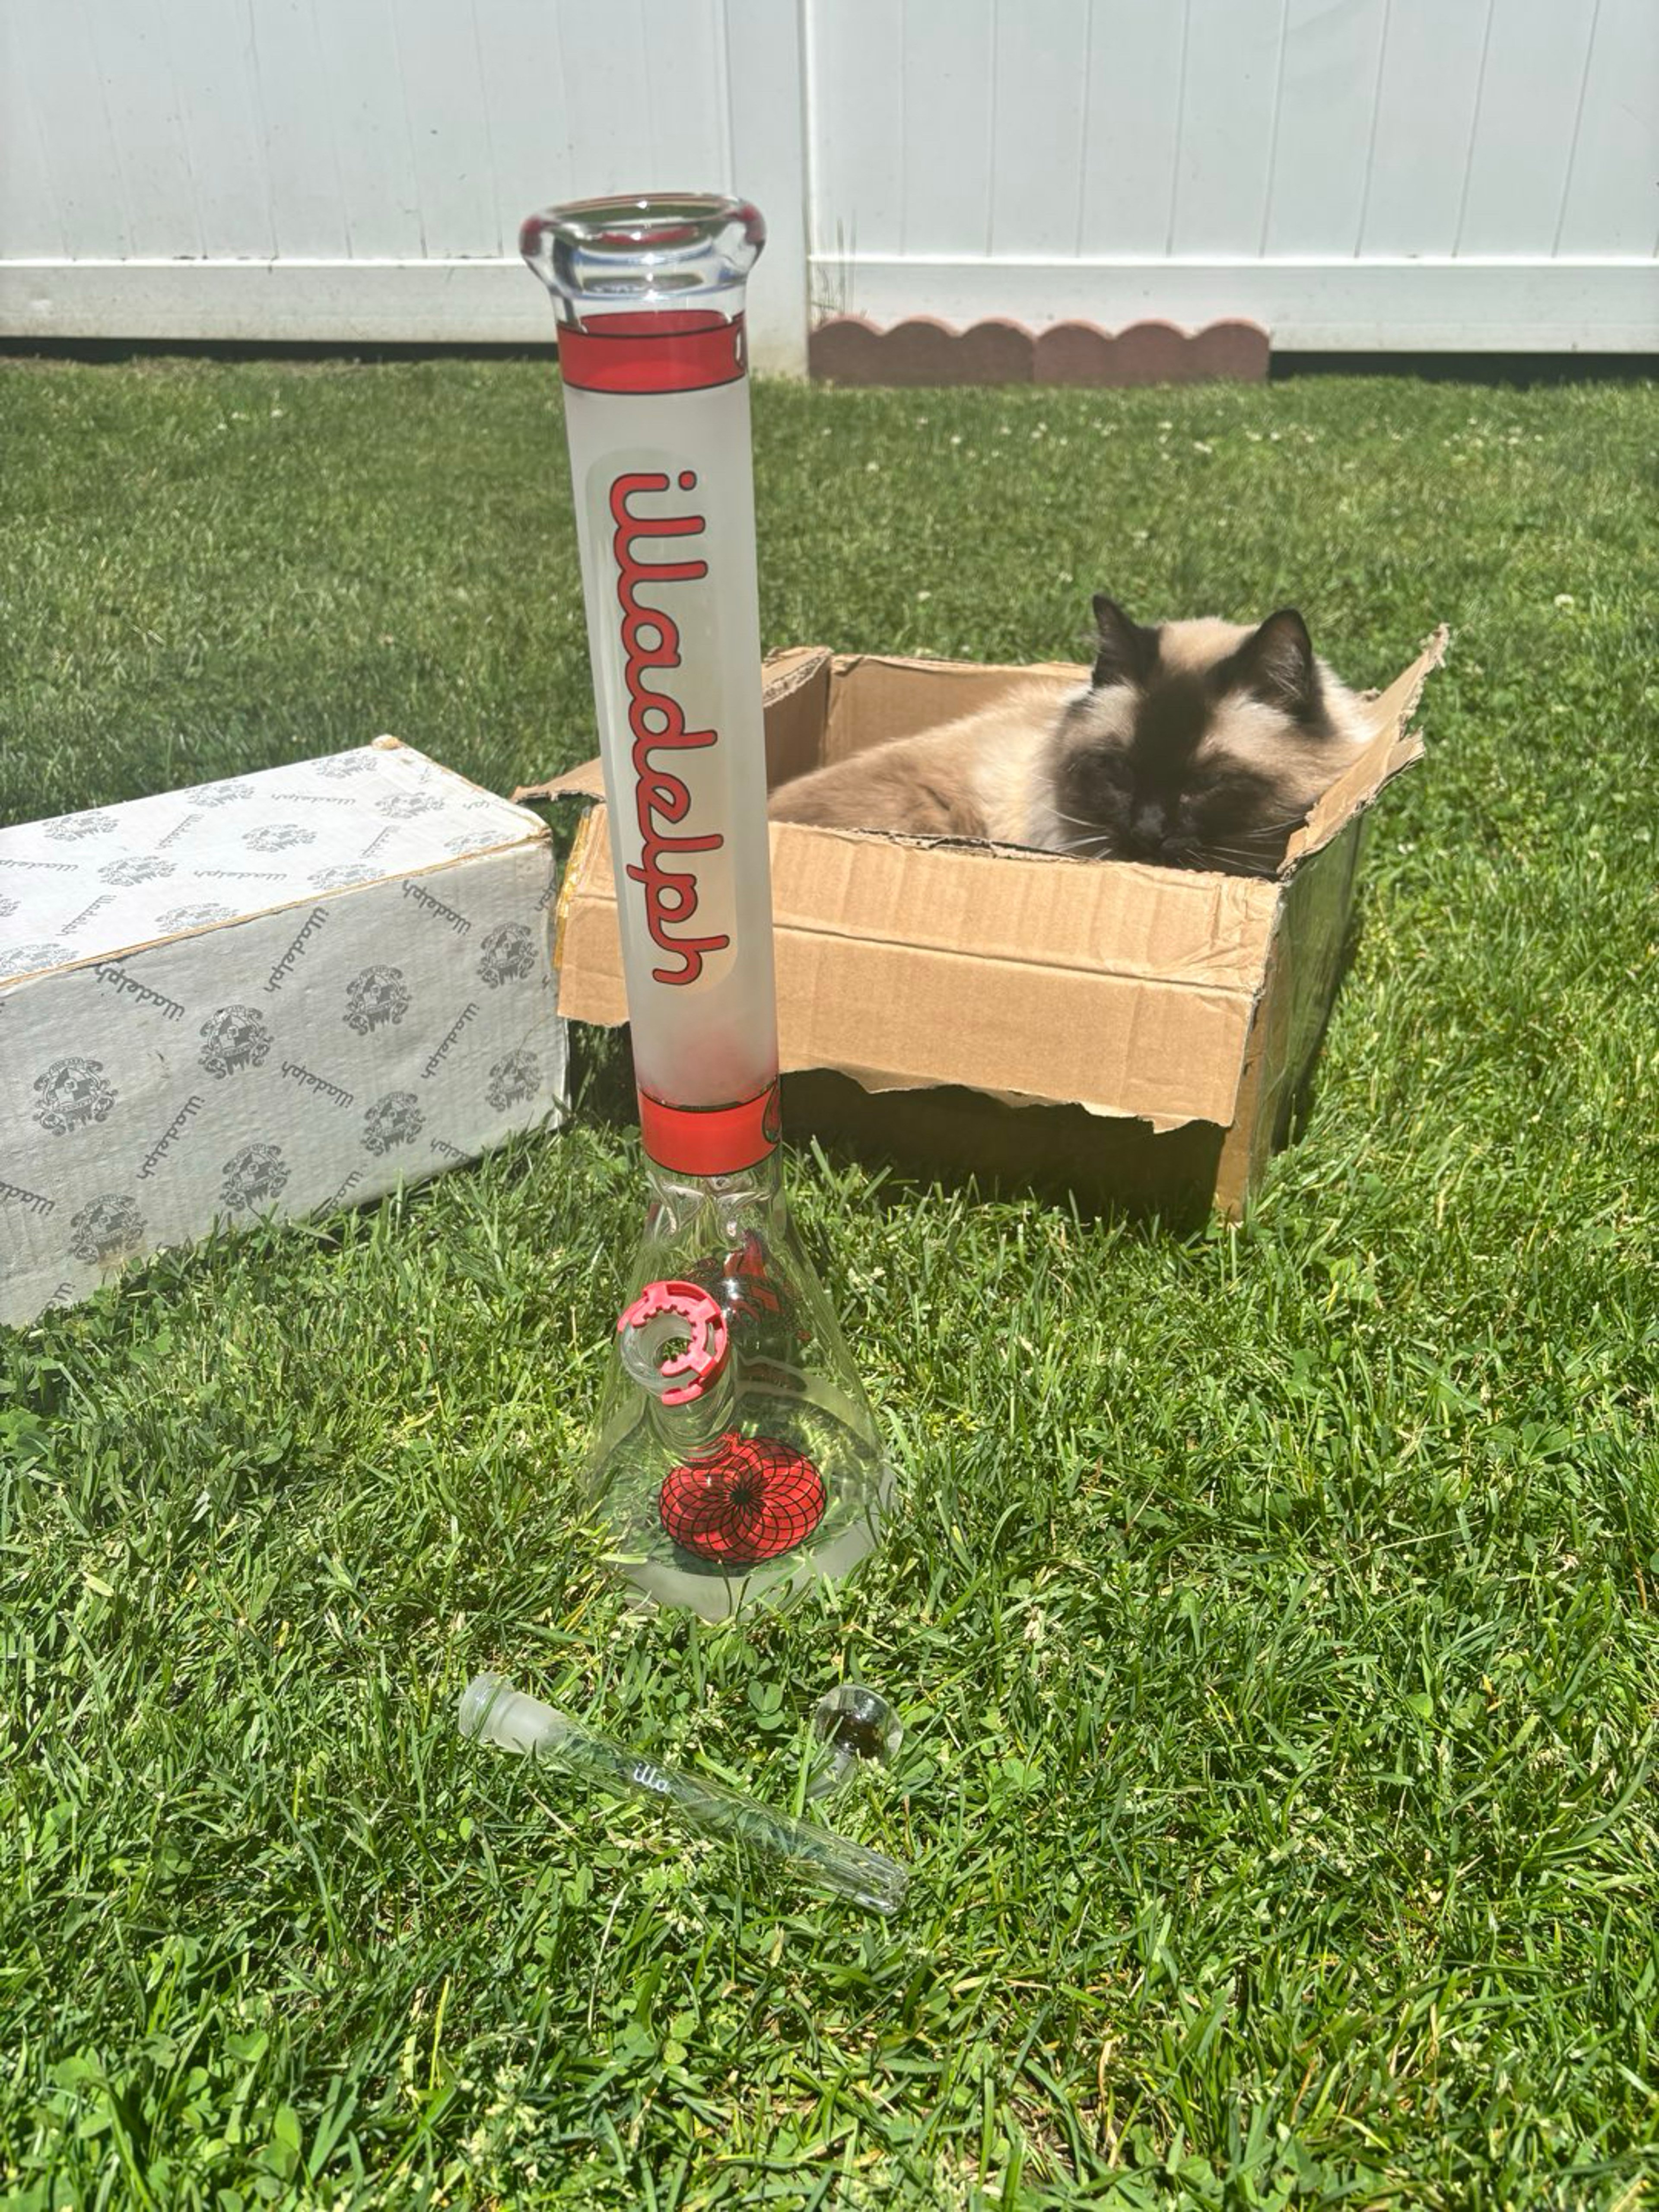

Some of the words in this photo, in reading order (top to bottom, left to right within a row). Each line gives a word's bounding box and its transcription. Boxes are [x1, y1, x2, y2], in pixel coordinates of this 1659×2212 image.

[610, 471, 730, 985] illadelph
[0, 859, 78, 871] illadelp
[194, 870, 287, 880] illadelph
[401, 880, 471, 936] illadelph
[264, 907, 329, 993] illadelph
[95, 966, 184, 1021] illadelph
[421, 1002, 480, 1079] illadelph
[281, 1061, 354, 1108] illadelph
[136, 1095, 205, 1180] illadelph
[430, 1138, 467, 1165] delph
[325, 1163, 367, 1211] illad
